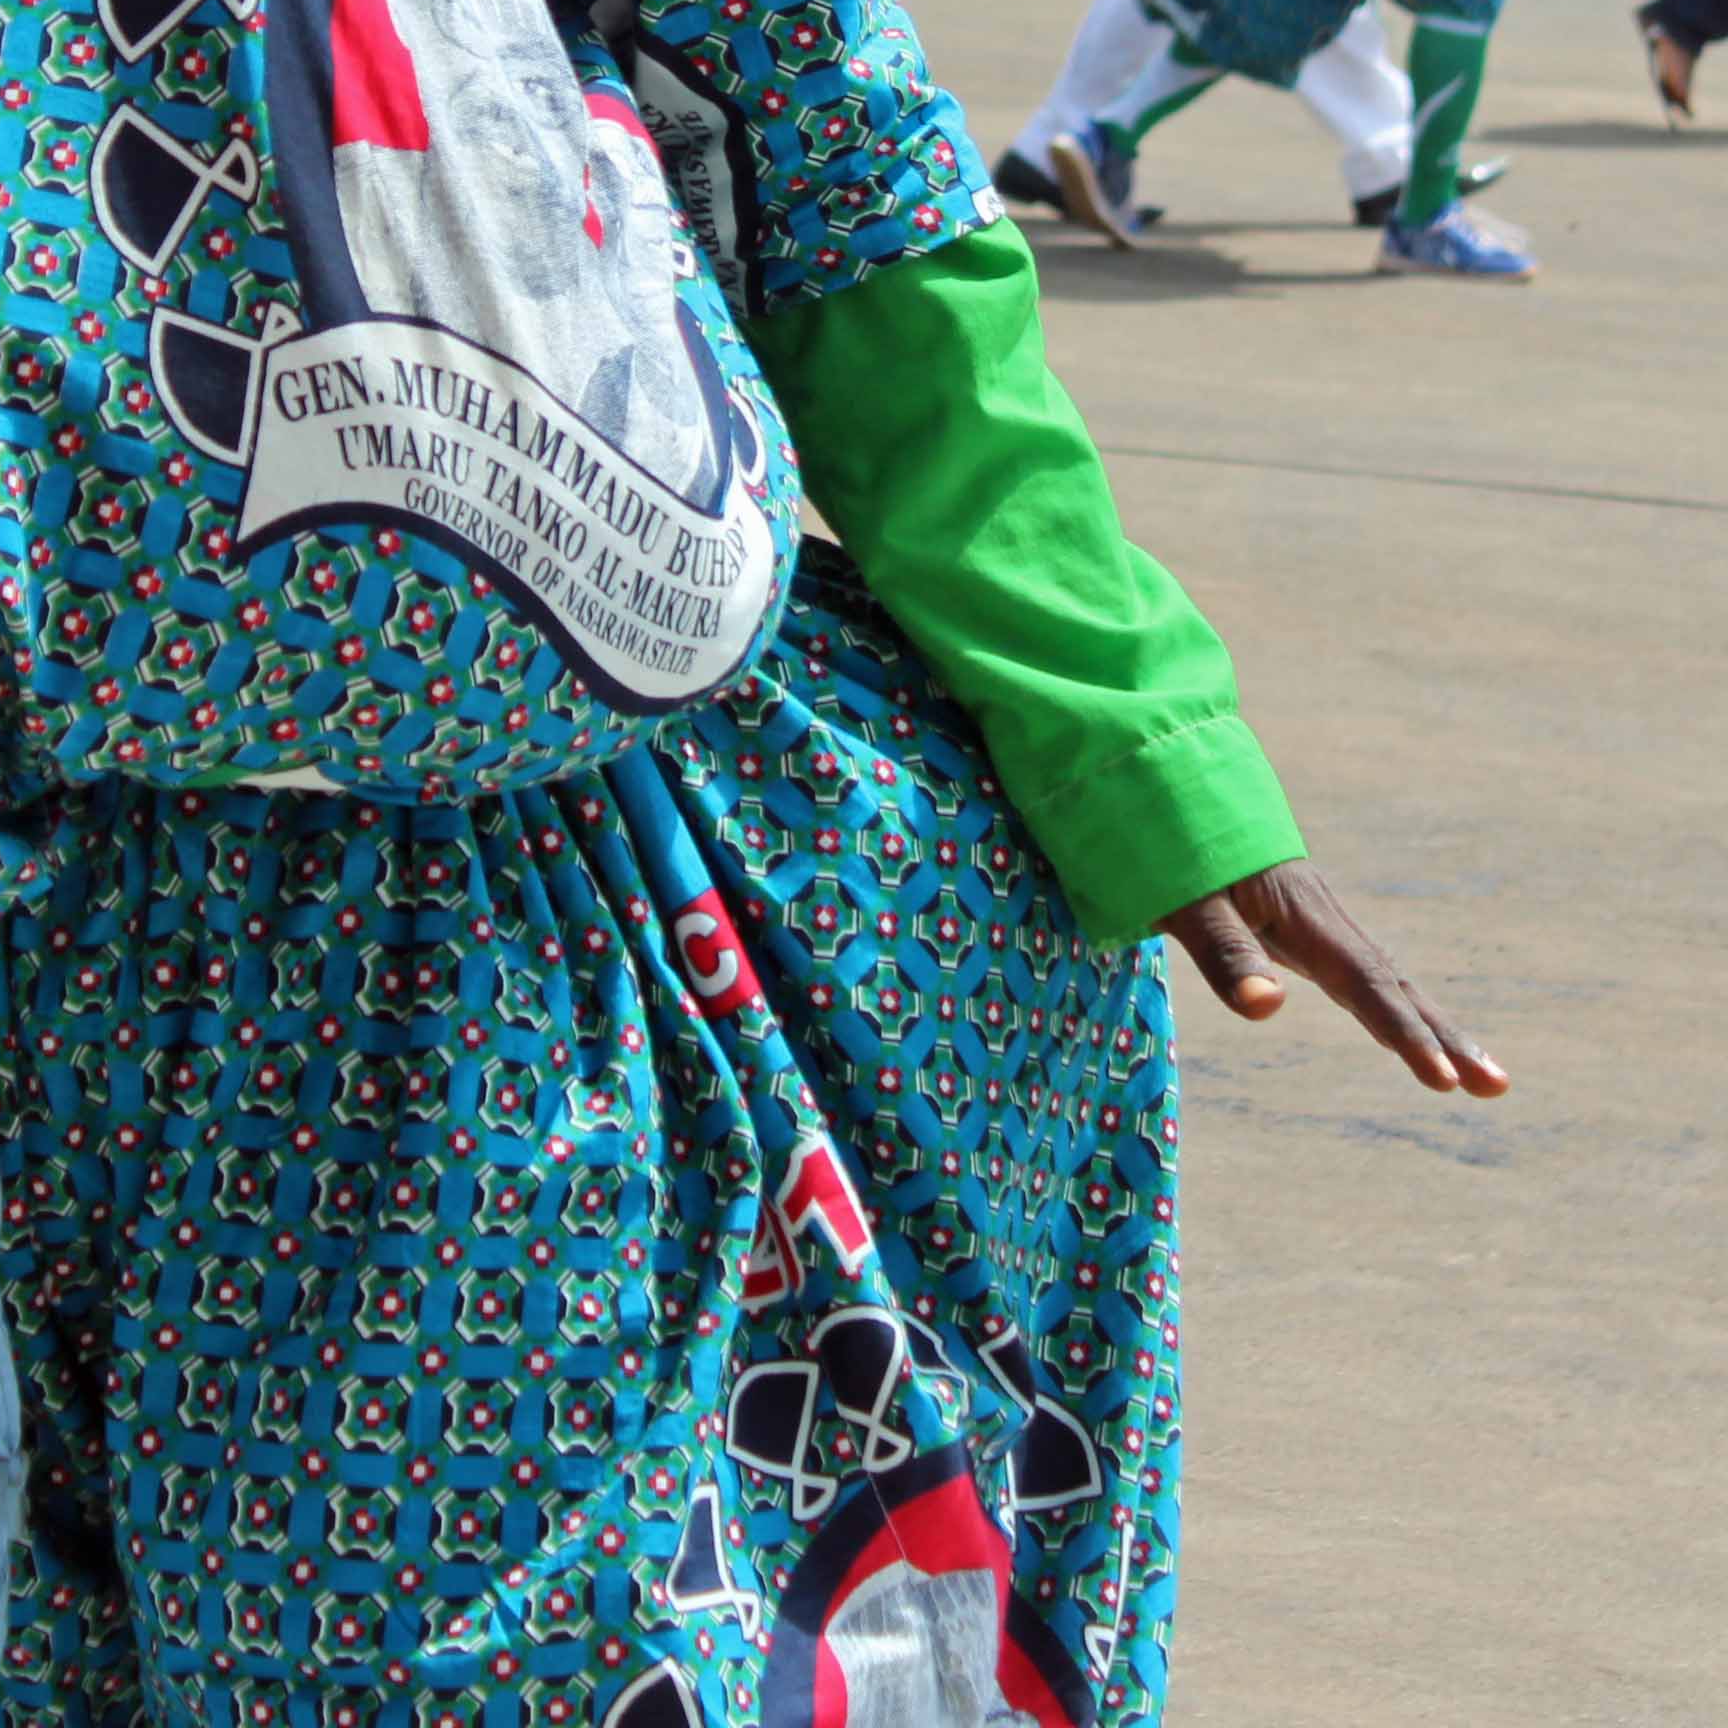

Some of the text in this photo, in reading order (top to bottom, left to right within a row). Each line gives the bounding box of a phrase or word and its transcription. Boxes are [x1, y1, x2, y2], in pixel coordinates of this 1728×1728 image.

[272, 355, 385, 423] GEN.
[390, 356, 671, 556] MUHAMMADU
[481, 455, 589, 564] TANKO
[404, 474, 529, 575] GOVERNOR
[531, 555, 568, 596] OF
